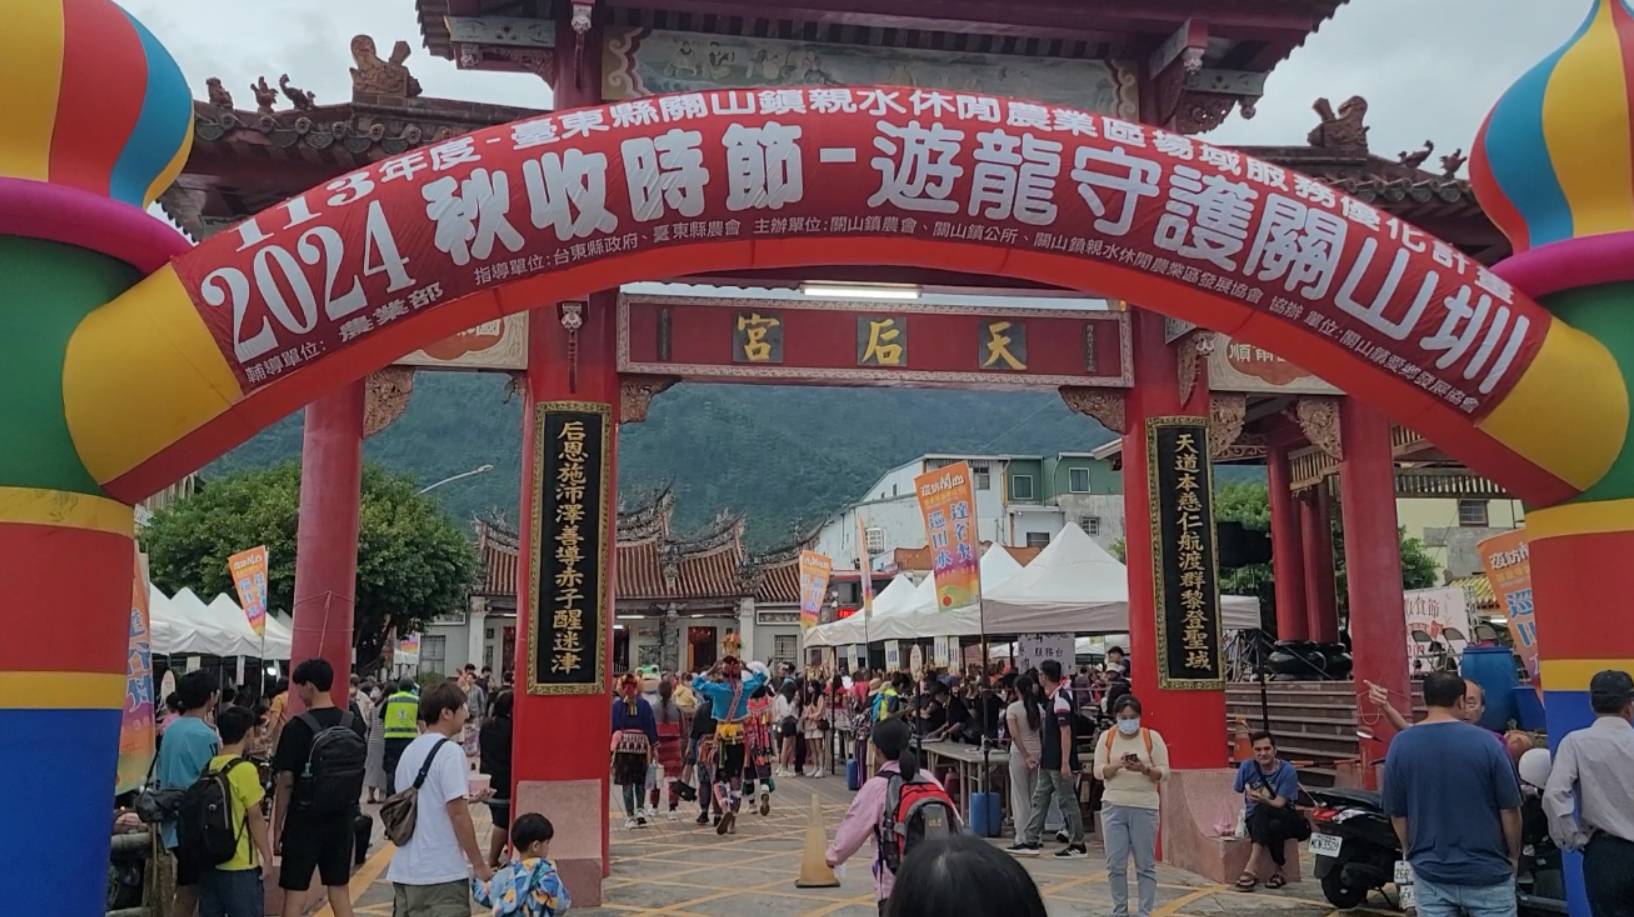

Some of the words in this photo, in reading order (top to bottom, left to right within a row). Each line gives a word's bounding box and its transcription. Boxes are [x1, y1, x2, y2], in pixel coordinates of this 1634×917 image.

[201, 201, 415, 362] 2024
[339, 282, 443, 342] 農業部
[737, 312, 1027, 370] 天后宮
